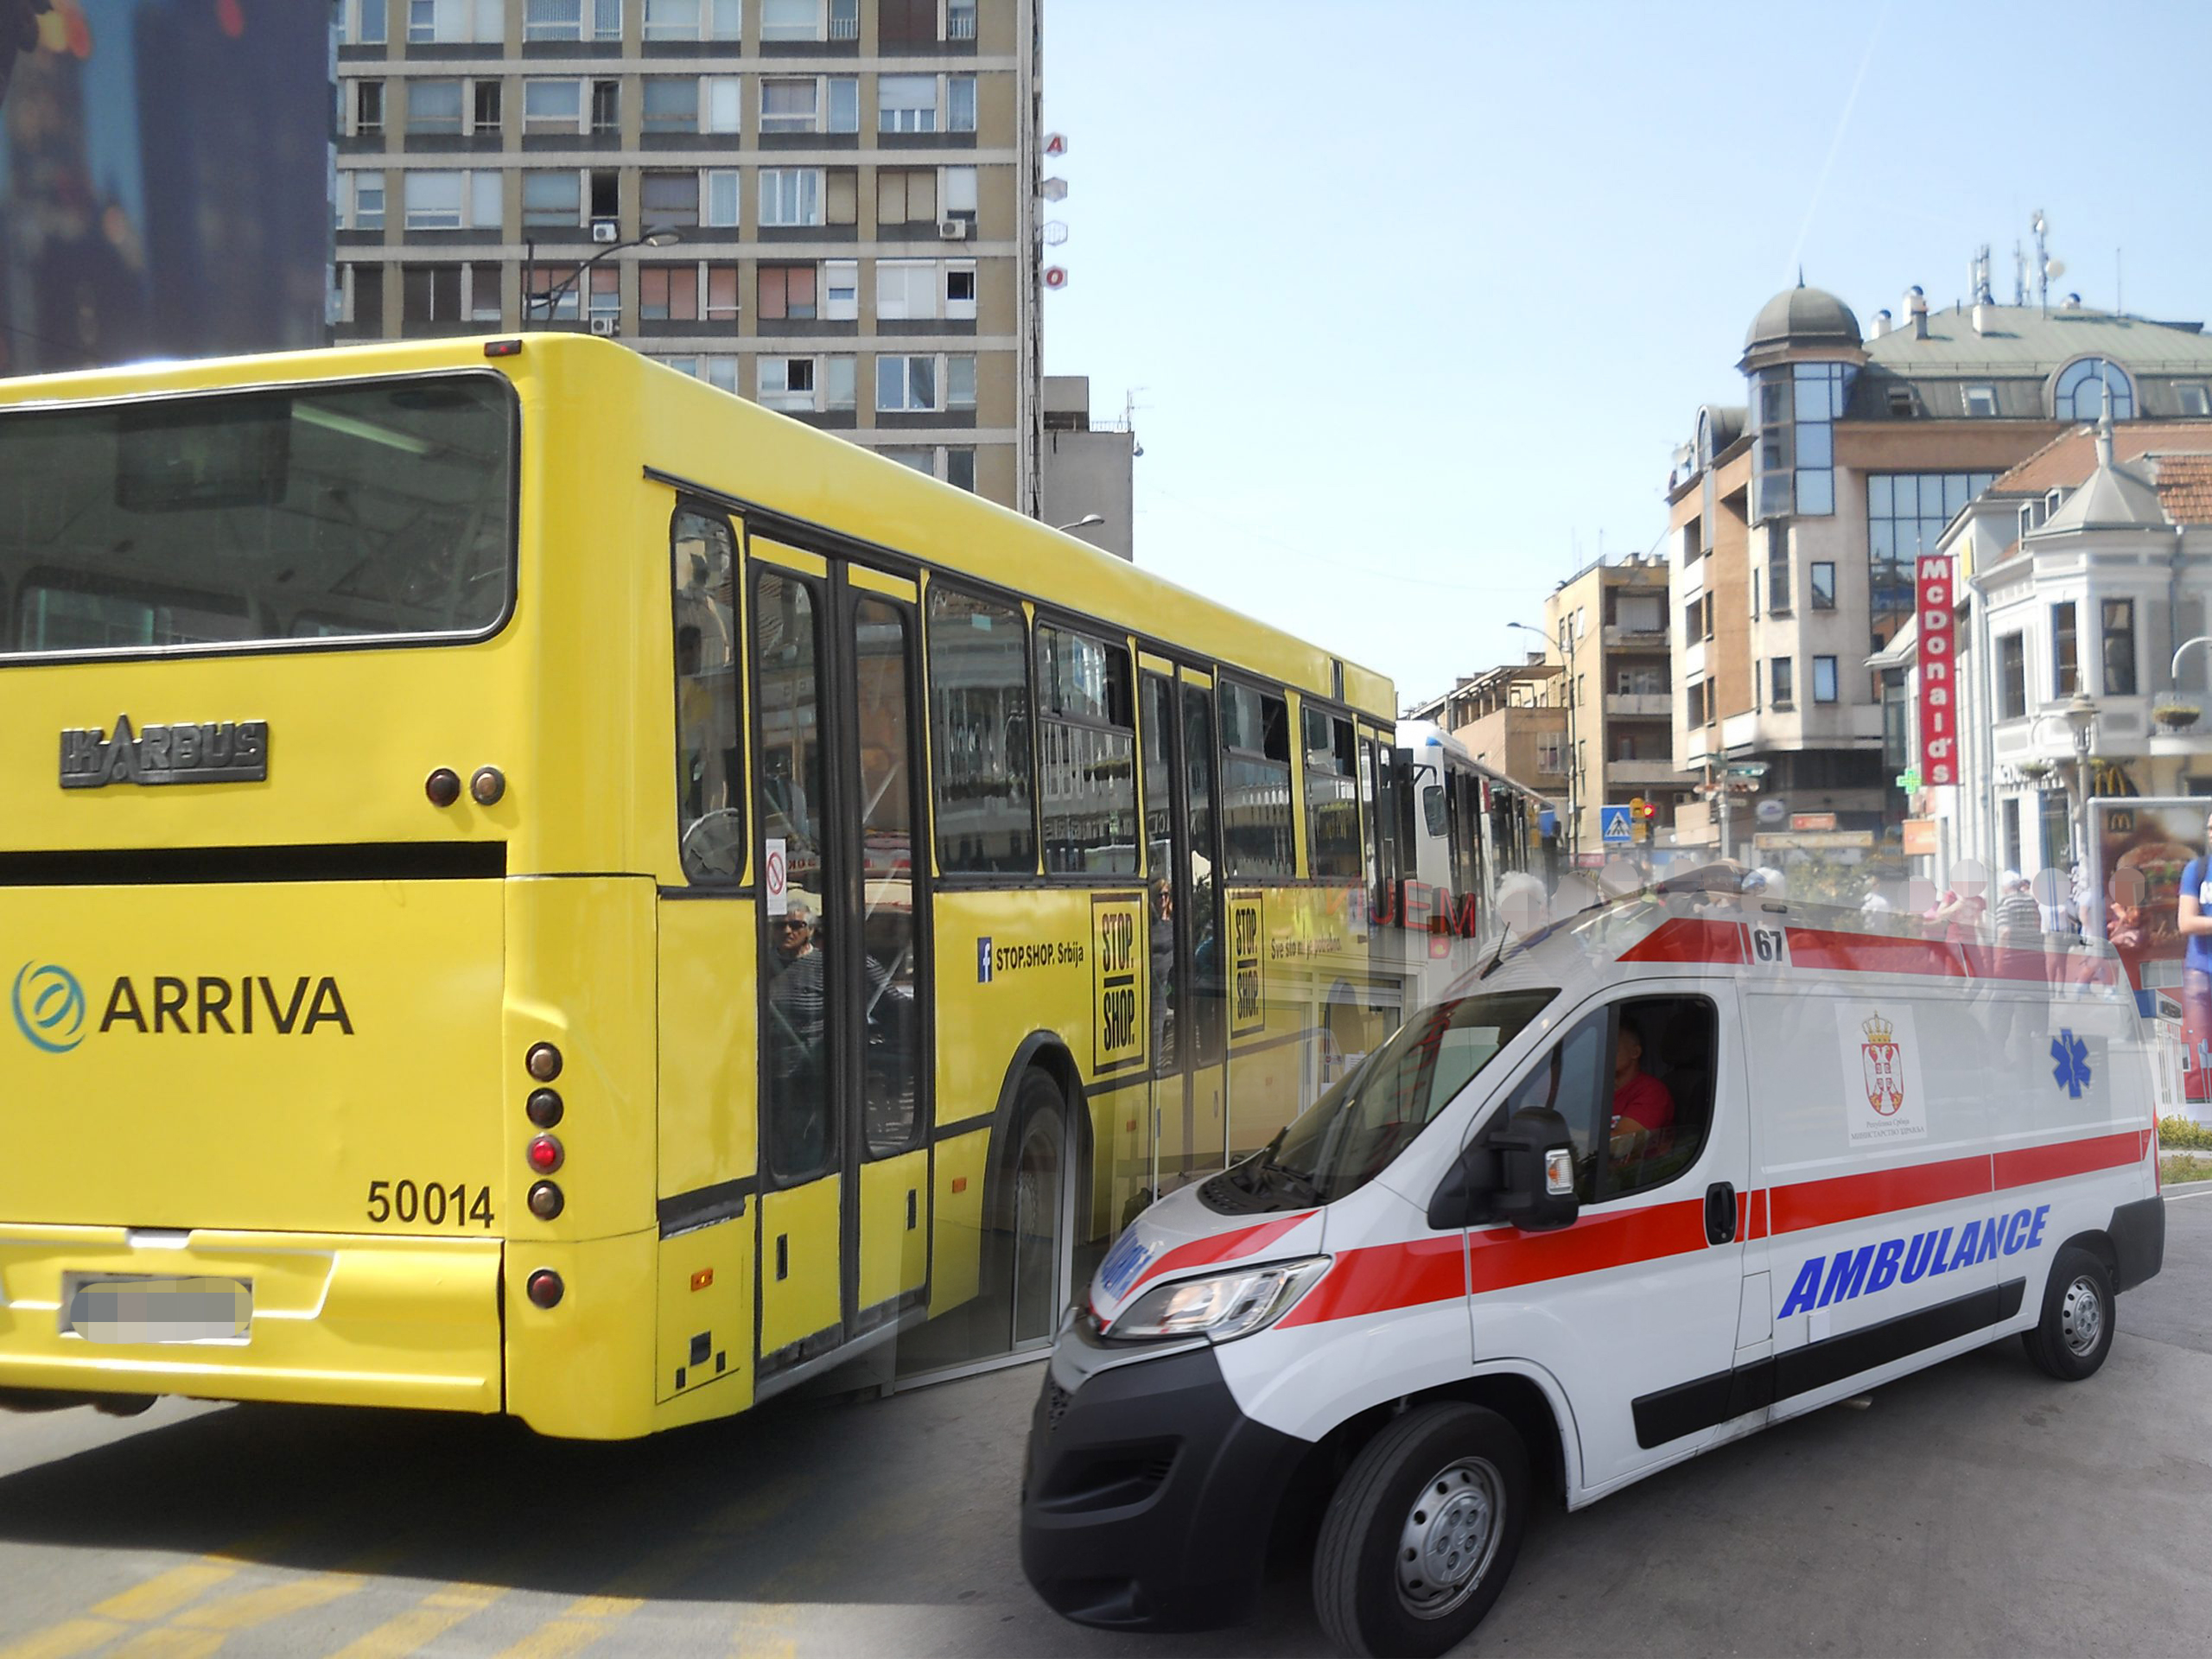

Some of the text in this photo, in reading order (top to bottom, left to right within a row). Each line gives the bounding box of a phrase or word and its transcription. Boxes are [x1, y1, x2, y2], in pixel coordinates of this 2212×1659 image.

[1921, 560, 1953, 784] McDonald's
[60, 713, 268, 785] IKARBUS
[1058, 941, 1084, 968] Srbija
[1754, 929, 1783, 962] 67
[99, 976, 354, 1035] ARRIVA
[1103, 988, 1135, 1051] SHOP.
[367, 1179, 495, 1229] 50014
[1777, 1204, 2050, 1320] AMBULANCE
